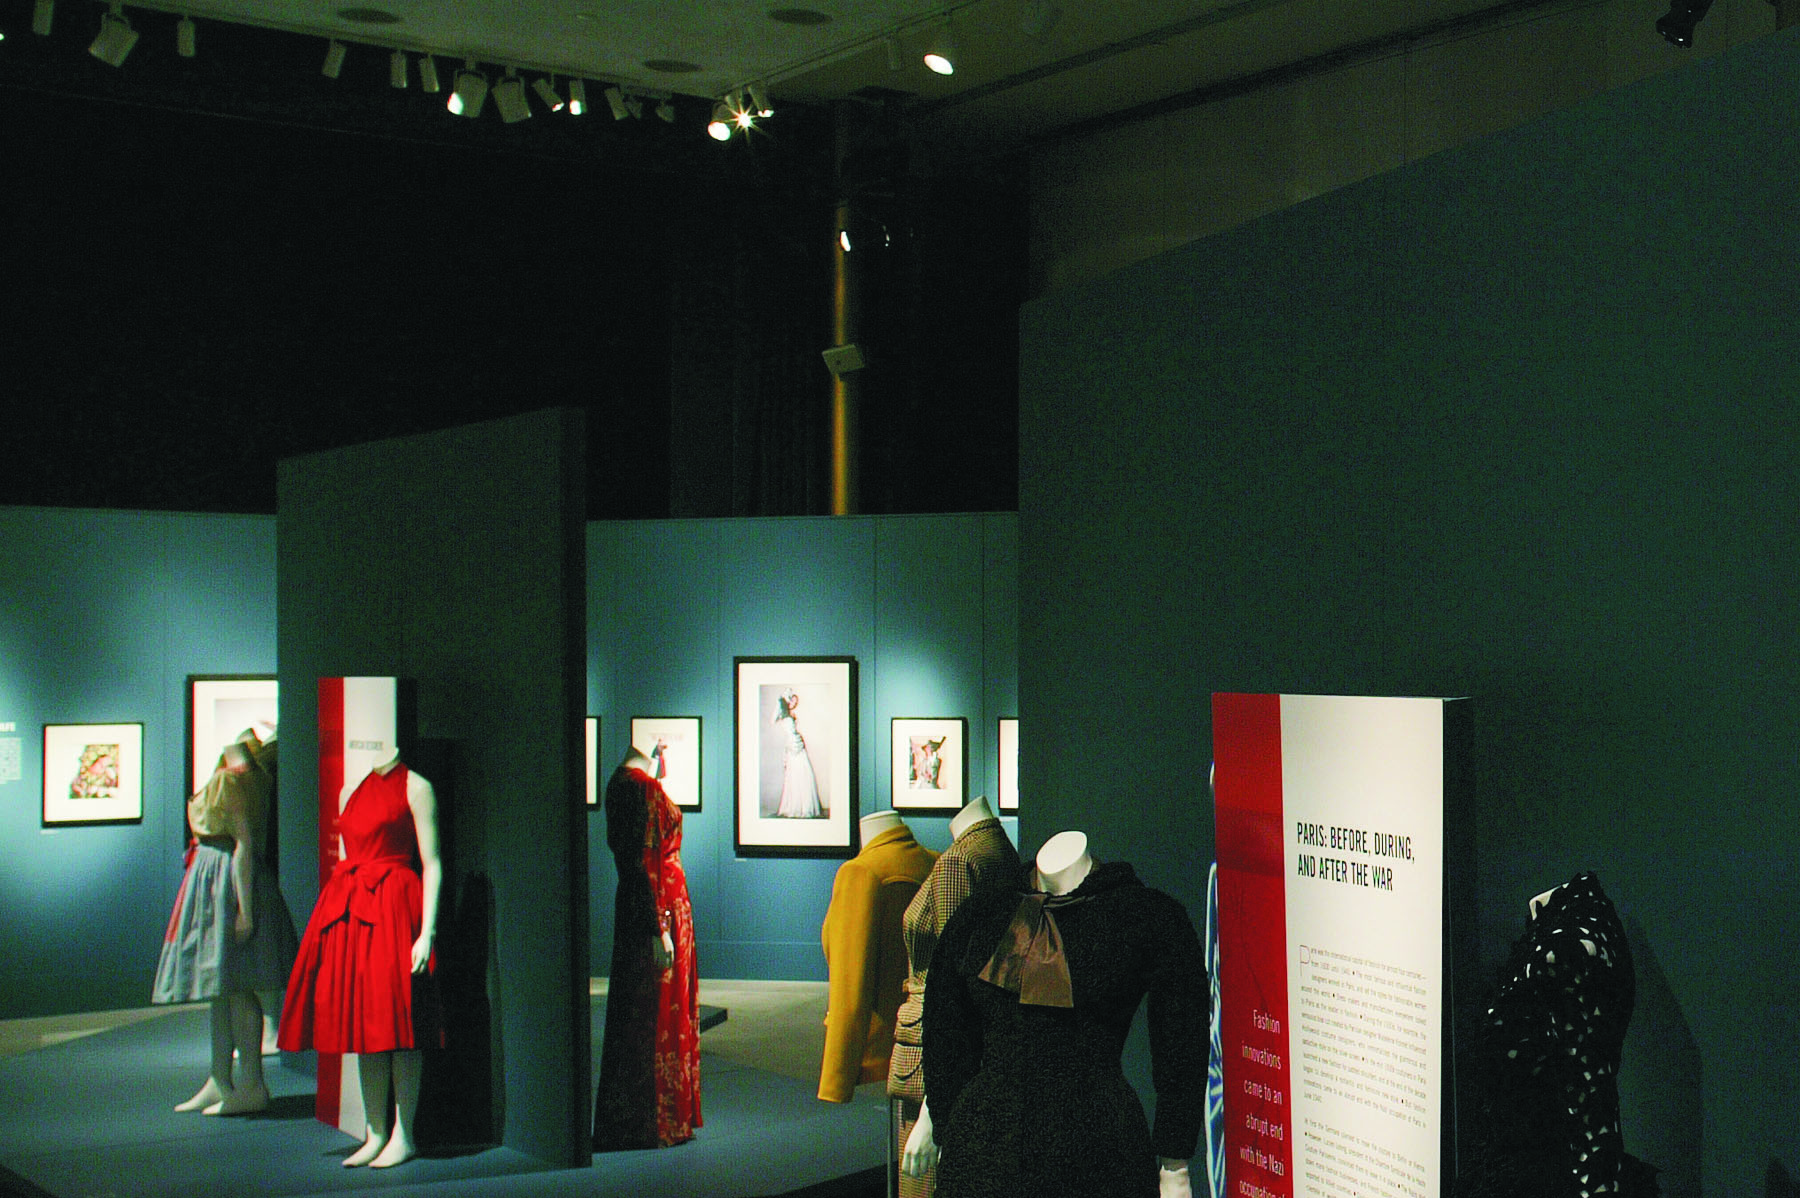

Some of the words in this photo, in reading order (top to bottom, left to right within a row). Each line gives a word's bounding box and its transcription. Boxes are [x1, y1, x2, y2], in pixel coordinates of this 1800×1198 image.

[1297, 822, 1327, 848] PARIS:
[1330, 826, 1371, 857] BEFORE,
[1374, 832, 1415, 864] DURING,
[1298, 853, 1316, 878] AND
[1319, 857, 1348, 883] AFTER
[1351, 862, 1369, 887] THE
[1372, 865, 1393, 892] WAR
[1253, 1009, 1280, 1034] Fashion
[1241, 1040, 1282, 1070] innovations
[1243, 1079, 1262, 1099] came
[1264, 1083, 1272, 1102] to
[1273, 1090, 1282, 1105] an
[1246, 1112, 1269, 1136] abrupt
[1270, 1123, 1284, 1141] end
[1239, 1144, 1255, 1165] with
[1256, 1148, 1268, 1170] the
[1269, 1153, 1285, 1177] Nazi
